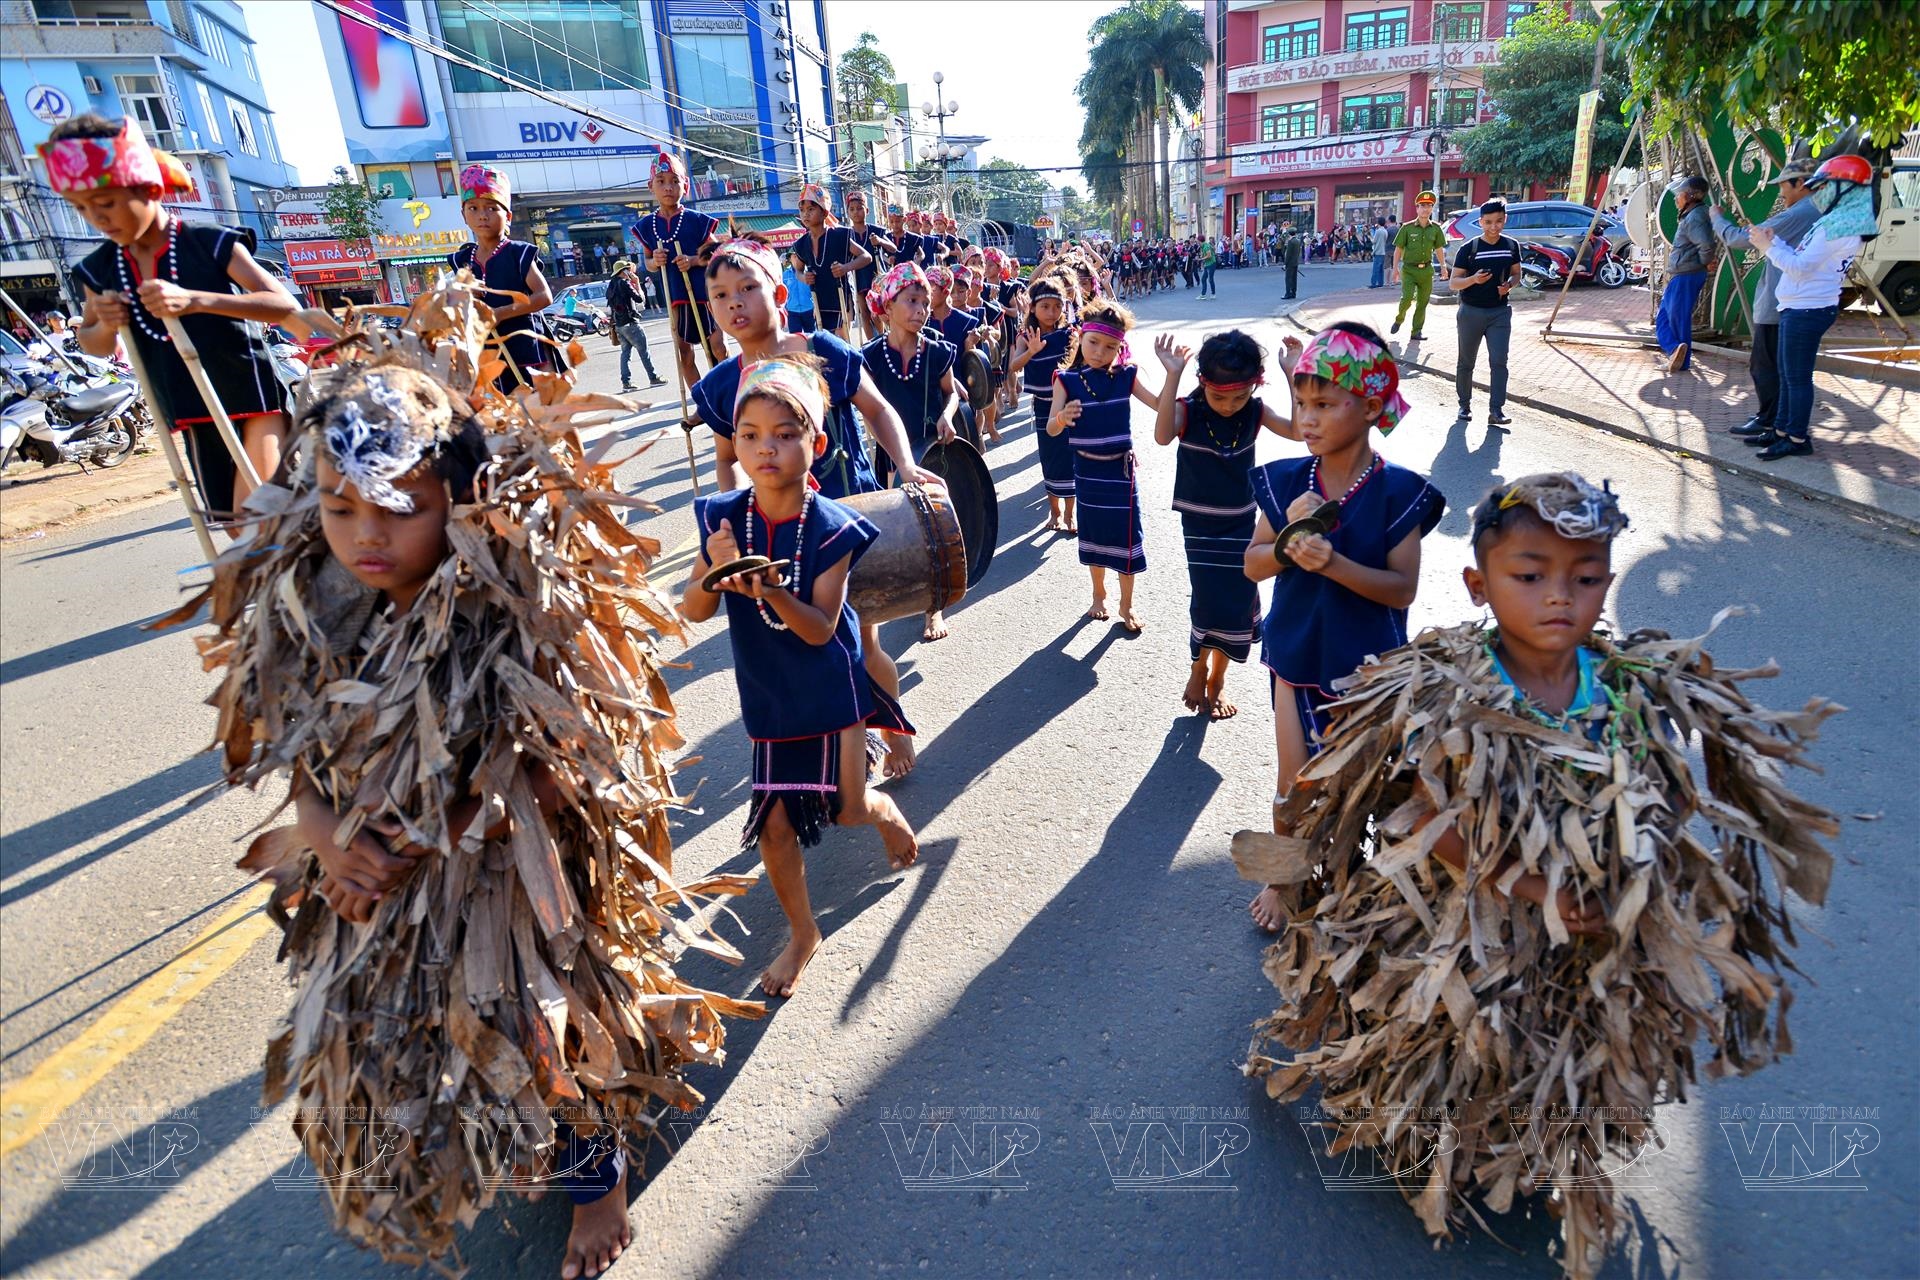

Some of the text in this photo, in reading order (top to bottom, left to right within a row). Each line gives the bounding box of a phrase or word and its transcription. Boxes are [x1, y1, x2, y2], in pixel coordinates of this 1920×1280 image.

[1237, 69, 1260, 88] NÓI
[1263, 63, 1294, 83] ĐẾN
[1297, 60, 1330, 79] BẢO
[1387, 50, 1430, 69] NGHĨ
[519, 121, 578, 143] BIDV
[300, 191, 324, 201] THOẠI
[279, 213, 319, 229] TRỌNG
[291, 247, 318, 262] BÁN
[319, 244, 343, 260] TRẢ
